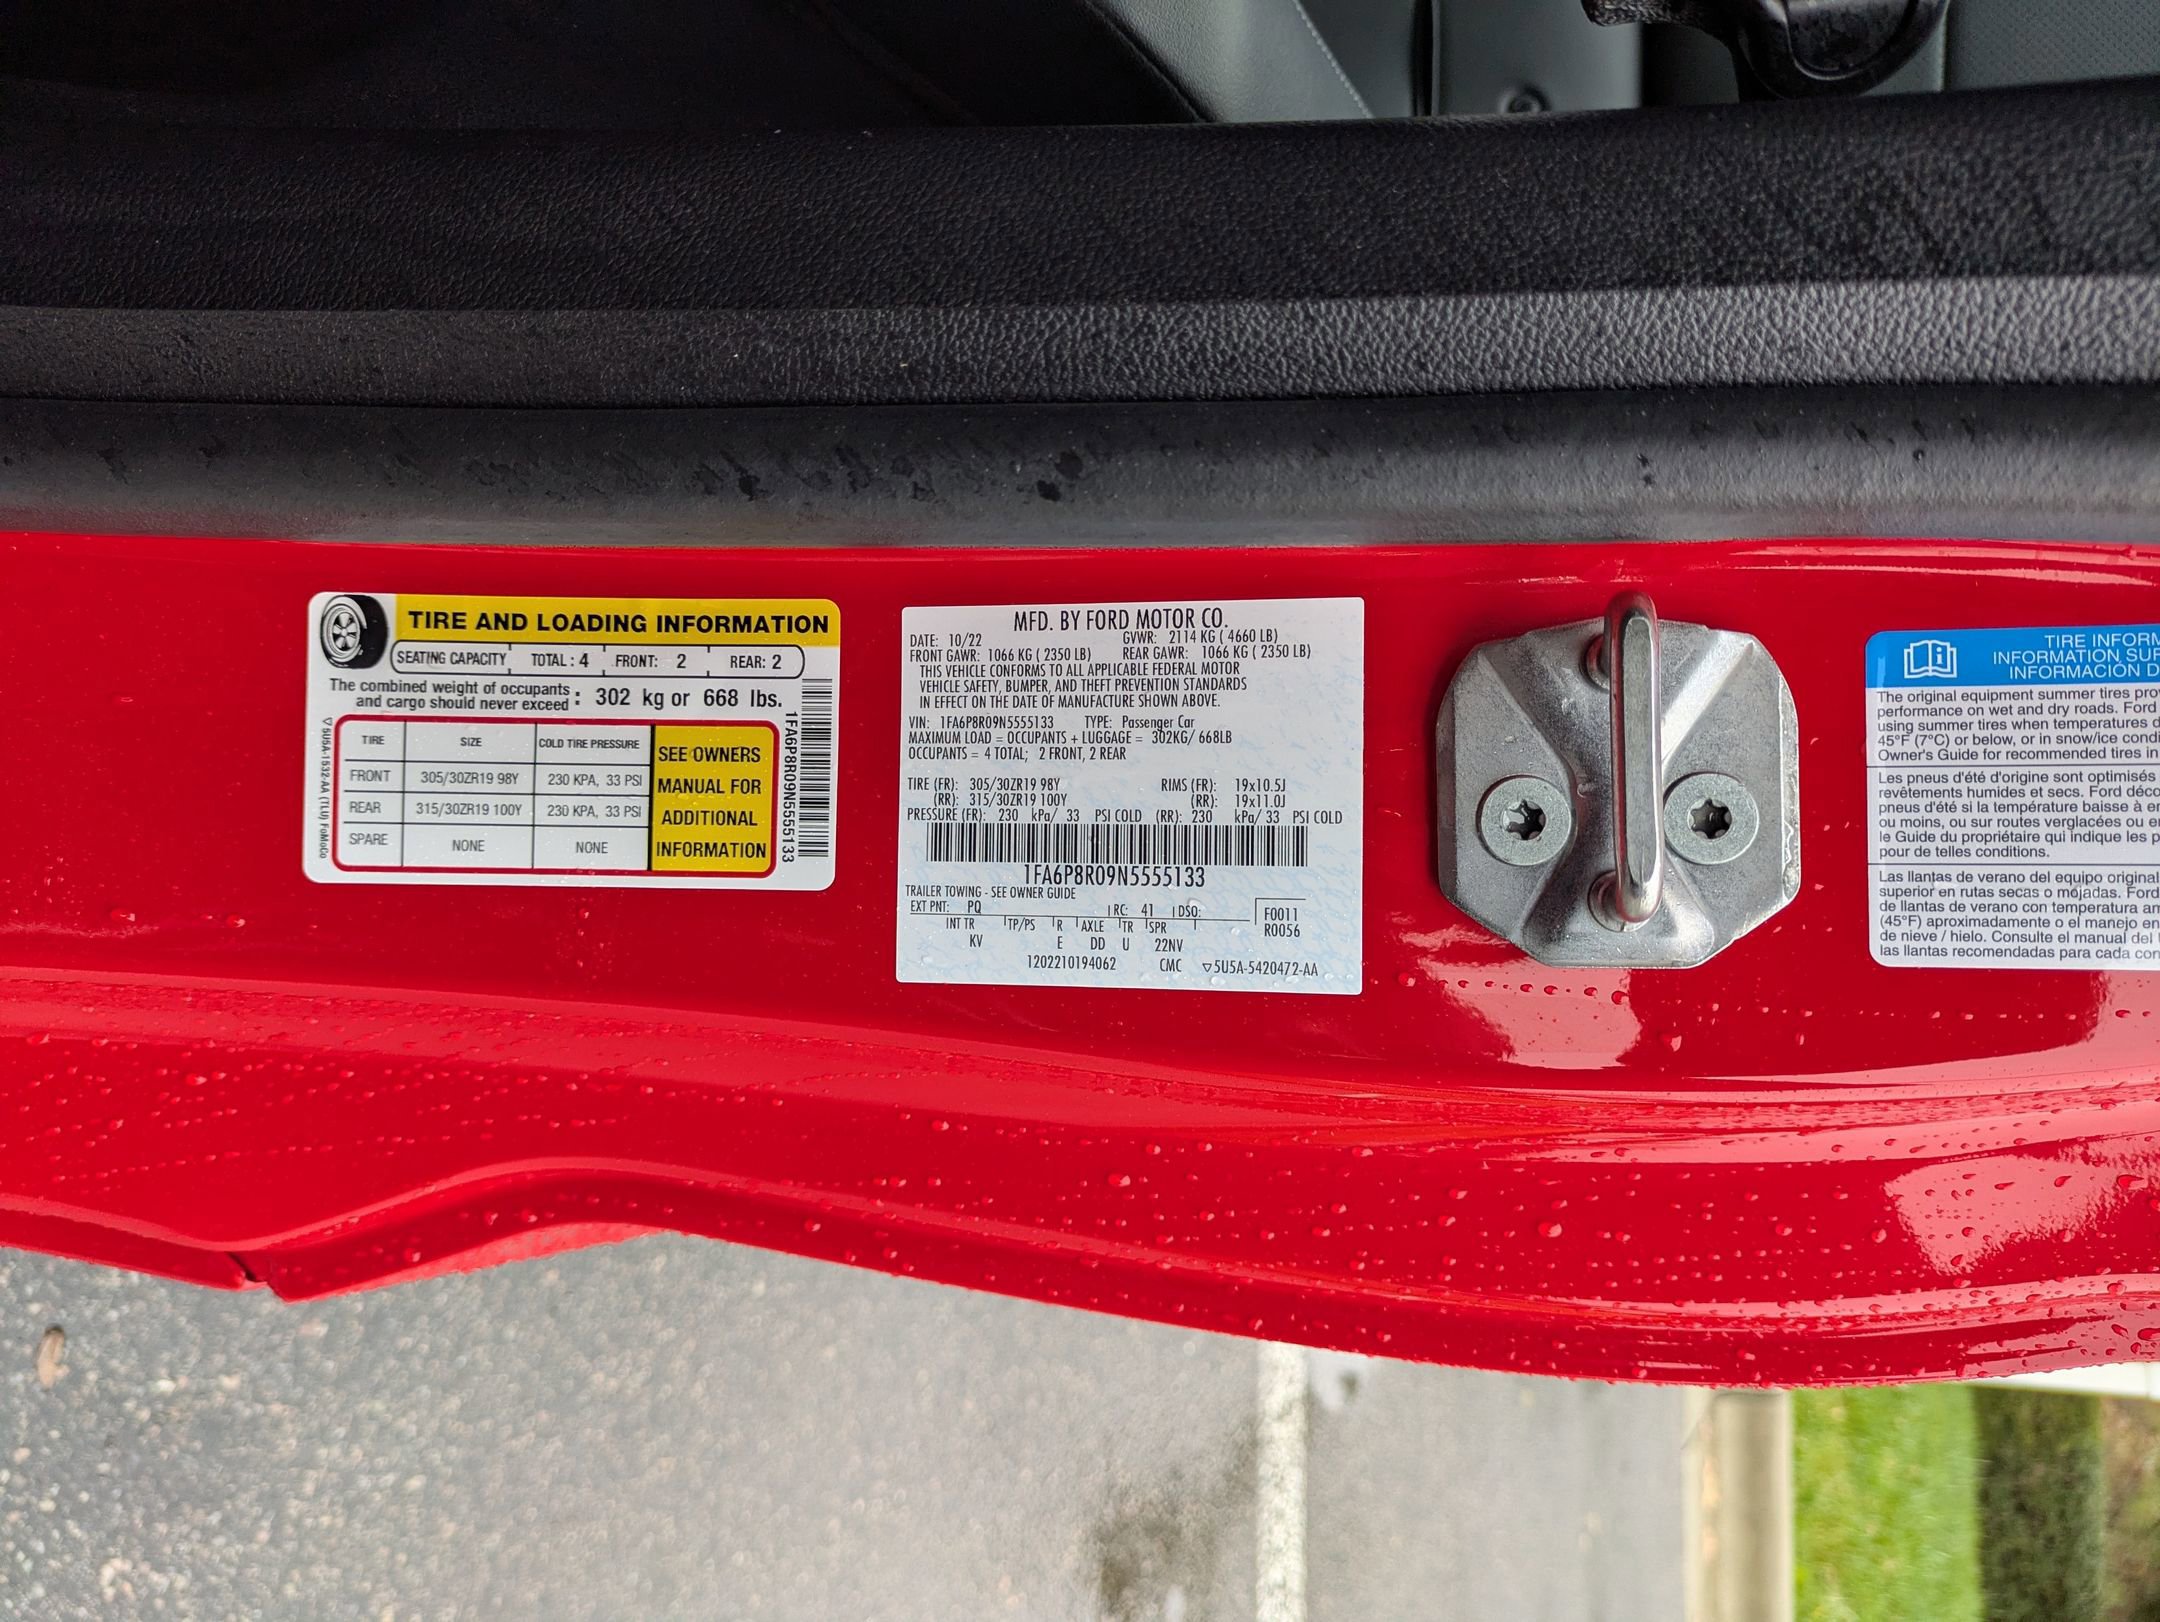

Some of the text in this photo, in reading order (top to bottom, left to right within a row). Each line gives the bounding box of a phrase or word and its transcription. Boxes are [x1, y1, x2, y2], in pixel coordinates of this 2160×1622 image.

[408, 611, 829, 633] TIRE AND LOADING INFORMATION
[1014, 607, 1228, 632] MFD. BY FORD MOTOR CO.
[910, 632, 982, 648] DATE: 10/22
[2044, 634, 2086, 649] TIRE
[397, 652, 507, 666] SEATING CAPACITY
[579, 653, 589, 668] 4
[615, 653, 686, 668] FRONT: 2
[730, 654, 782, 669] REAR: 2
[1993, 649, 2119, 665] INFORMATION
[920, 661, 1240, 678] THIS VEHICLE CONFORMS TO ALL APPLICABLE FEDERAL MOTOR
[2009, 660, 2140, 679] INFORMACIÓN
[330, 678, 570, 699] The combined weight of occupants
[920, 677, 1247, 695] VEHICLE SAFETY, BUMPER, AND THEFT PREVENTION STANDARDS
[356, 695, 569, 712] and cargo should never exceed
[596, 688, 782, 710] 302 kg or 668 lbs.
[920, 693, 1220, 708] IN EFFECT ON THE DATE OF MANUFACTURE SHOWN ABOVE.
[1877, 691, 1903, 703] The
[1907, 690, 1957, 705] original
[1961, 689, 2034, 704] equipment
[2038, 688, 2095, 701] summer
[2099, 687, 2130, 700] tires
[1877, 701, 2157, 720] performance on wet and dry roads. Ford
[909, 716, 1054, 729] VIN: 1FA6P8R09N5555133
[1085, 715, 1195, 733] TYPE: Passenger Car
[1877, 720, 1913, 735] using
[1918, 720, 1973, 732] summer
[1978, 718, 2007, 731] tires
[2011, 717, 2048, 730] when
[2053, 717, 2148, 732] temperatures
[362, 735, 385, 745] TIRE
[461, 737, 482, 747] SIZE
[538, 738, 640, 749] COLD TIRE PRESSURE
[658, 746, 761, 763] SEE OWNERS
[350, 770, 391, 782] FRONT
[421, 771, 519, 787] 305/30ZR19 98Y
[548, 773, 642, 788] 230 KPA, 33 PSI
[907, 776, 1060, 792] TIRE (FR): 305/30ZR19 98Y
[1878, 770, 2156, 786] Les pneus d'été d'origine sont optimisés
[658, 778, 761, 794] MANUAL FOR
[782, 711, 798, 863] 1FA6P8R09N5555133
[1161, 778, 1287, 794] RIMS (FR): 19x10.5J
[350, 801, 381, 814] REAR
[416, 802, 522, 817] 315/30ZR19 100Y
[548, 804, 642, 819] 230 KPA, 33 PSI
[661, 810, 758, 826] ADDITIONAL
[319, 823, 329, 859] FoMoCo
[349, 833, 388, 846] SPARE
[452, 839, 485, 852] NONE
[576, 842, 608, 854] NONE
[657, 841, 766, 859] INFORMATION
[1025, 864, 1205, 888] 1FA6P8R09N5555133
[905, 885, 1076, 900] TRAILER TOWING SEE OWNER GUIDE
[1880, 945, 1899, 957] las
[1903, 945, 1948, 958] llantas
[1952, 945, 2055, 958] recomendadas
[2059, 947, 2091, 962] para
[2095, 946, 2130, 959] cada
[1027, 955, 1117, 970] 1202210194062
[1160, 958, 1182, 972] CMC
[1214, 959, 1319, 977] 5U5A-5420472-AA
